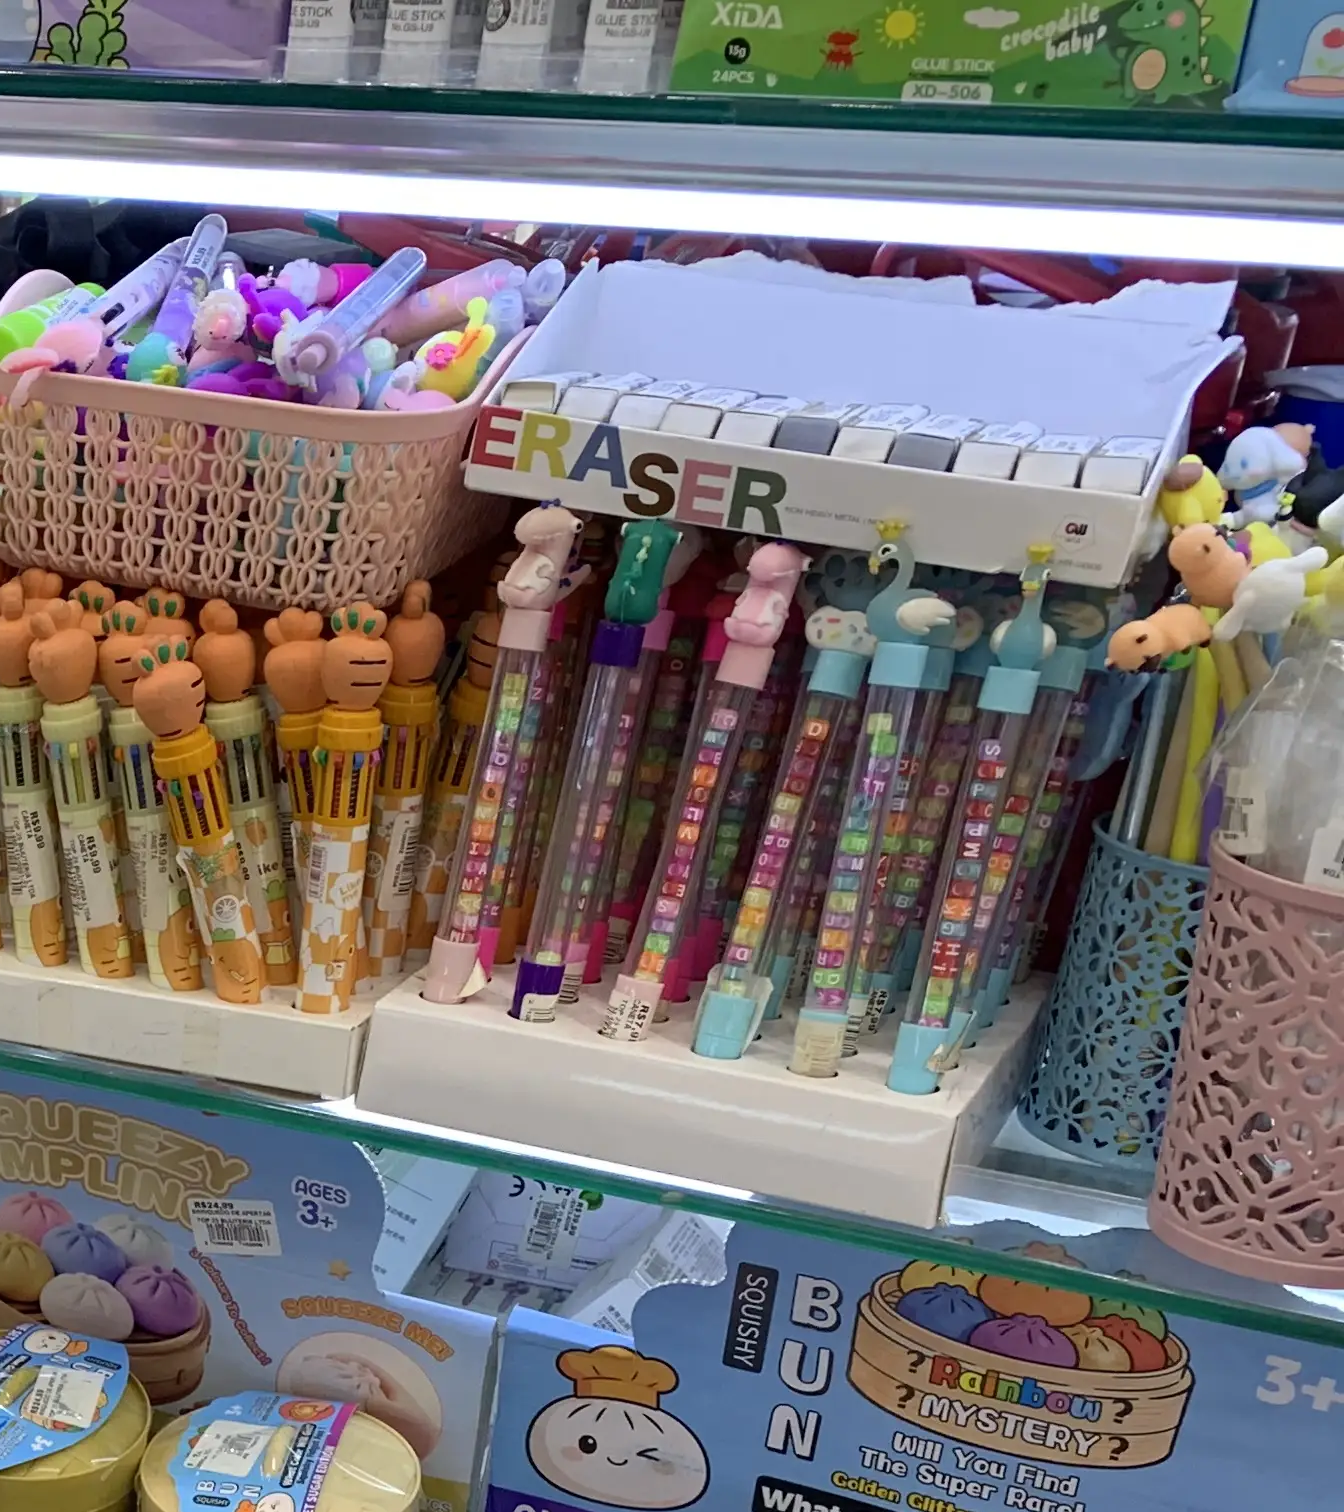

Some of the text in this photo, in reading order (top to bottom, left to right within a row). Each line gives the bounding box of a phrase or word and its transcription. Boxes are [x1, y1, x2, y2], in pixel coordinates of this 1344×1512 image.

[412, 10, 446, 22] STICK
[594, 14, 627, 27] GLUE
[1000, 2, 1101, 53] crocodile
[728, 44, 747, 60] 15g
[912, 58, 996, 73] GLUE STICK
[712, 70, 755, 86] 24PCS
[912, 83, 982, 101] XD-506
[471, 404, 788, 535] ERASER
[194, 1202, 234, 1210] R$24,99
[294, 1178, 348, 1205] AGES
[299, 1199, 335, 1229] 3+
[225, 1299, 241, 1321] To
[280, 1295, 405, 1334] SQUEEZE
[732, 1272, 769, 1368] SQUISHY
[764, 1272, 844, 1462] BUN
[927, 1354, 1104, 1423] Rainbow
[1256, 1354, 1344, 1413] 3+
[918, 1393, 1103, 1458] MYSTERY
[315, 1445, 336, 1474] EDITION
[859, 1445, 908, 1477] The
[915, 1463, 998, 1502] Super
[892, 1431, 1081, 1498] Will You Find
[195, 1480, 263, 1499] BUN
[308, 1470, 325, 1502] SUGAR
[832, 1471, 901, 1505] Golden
